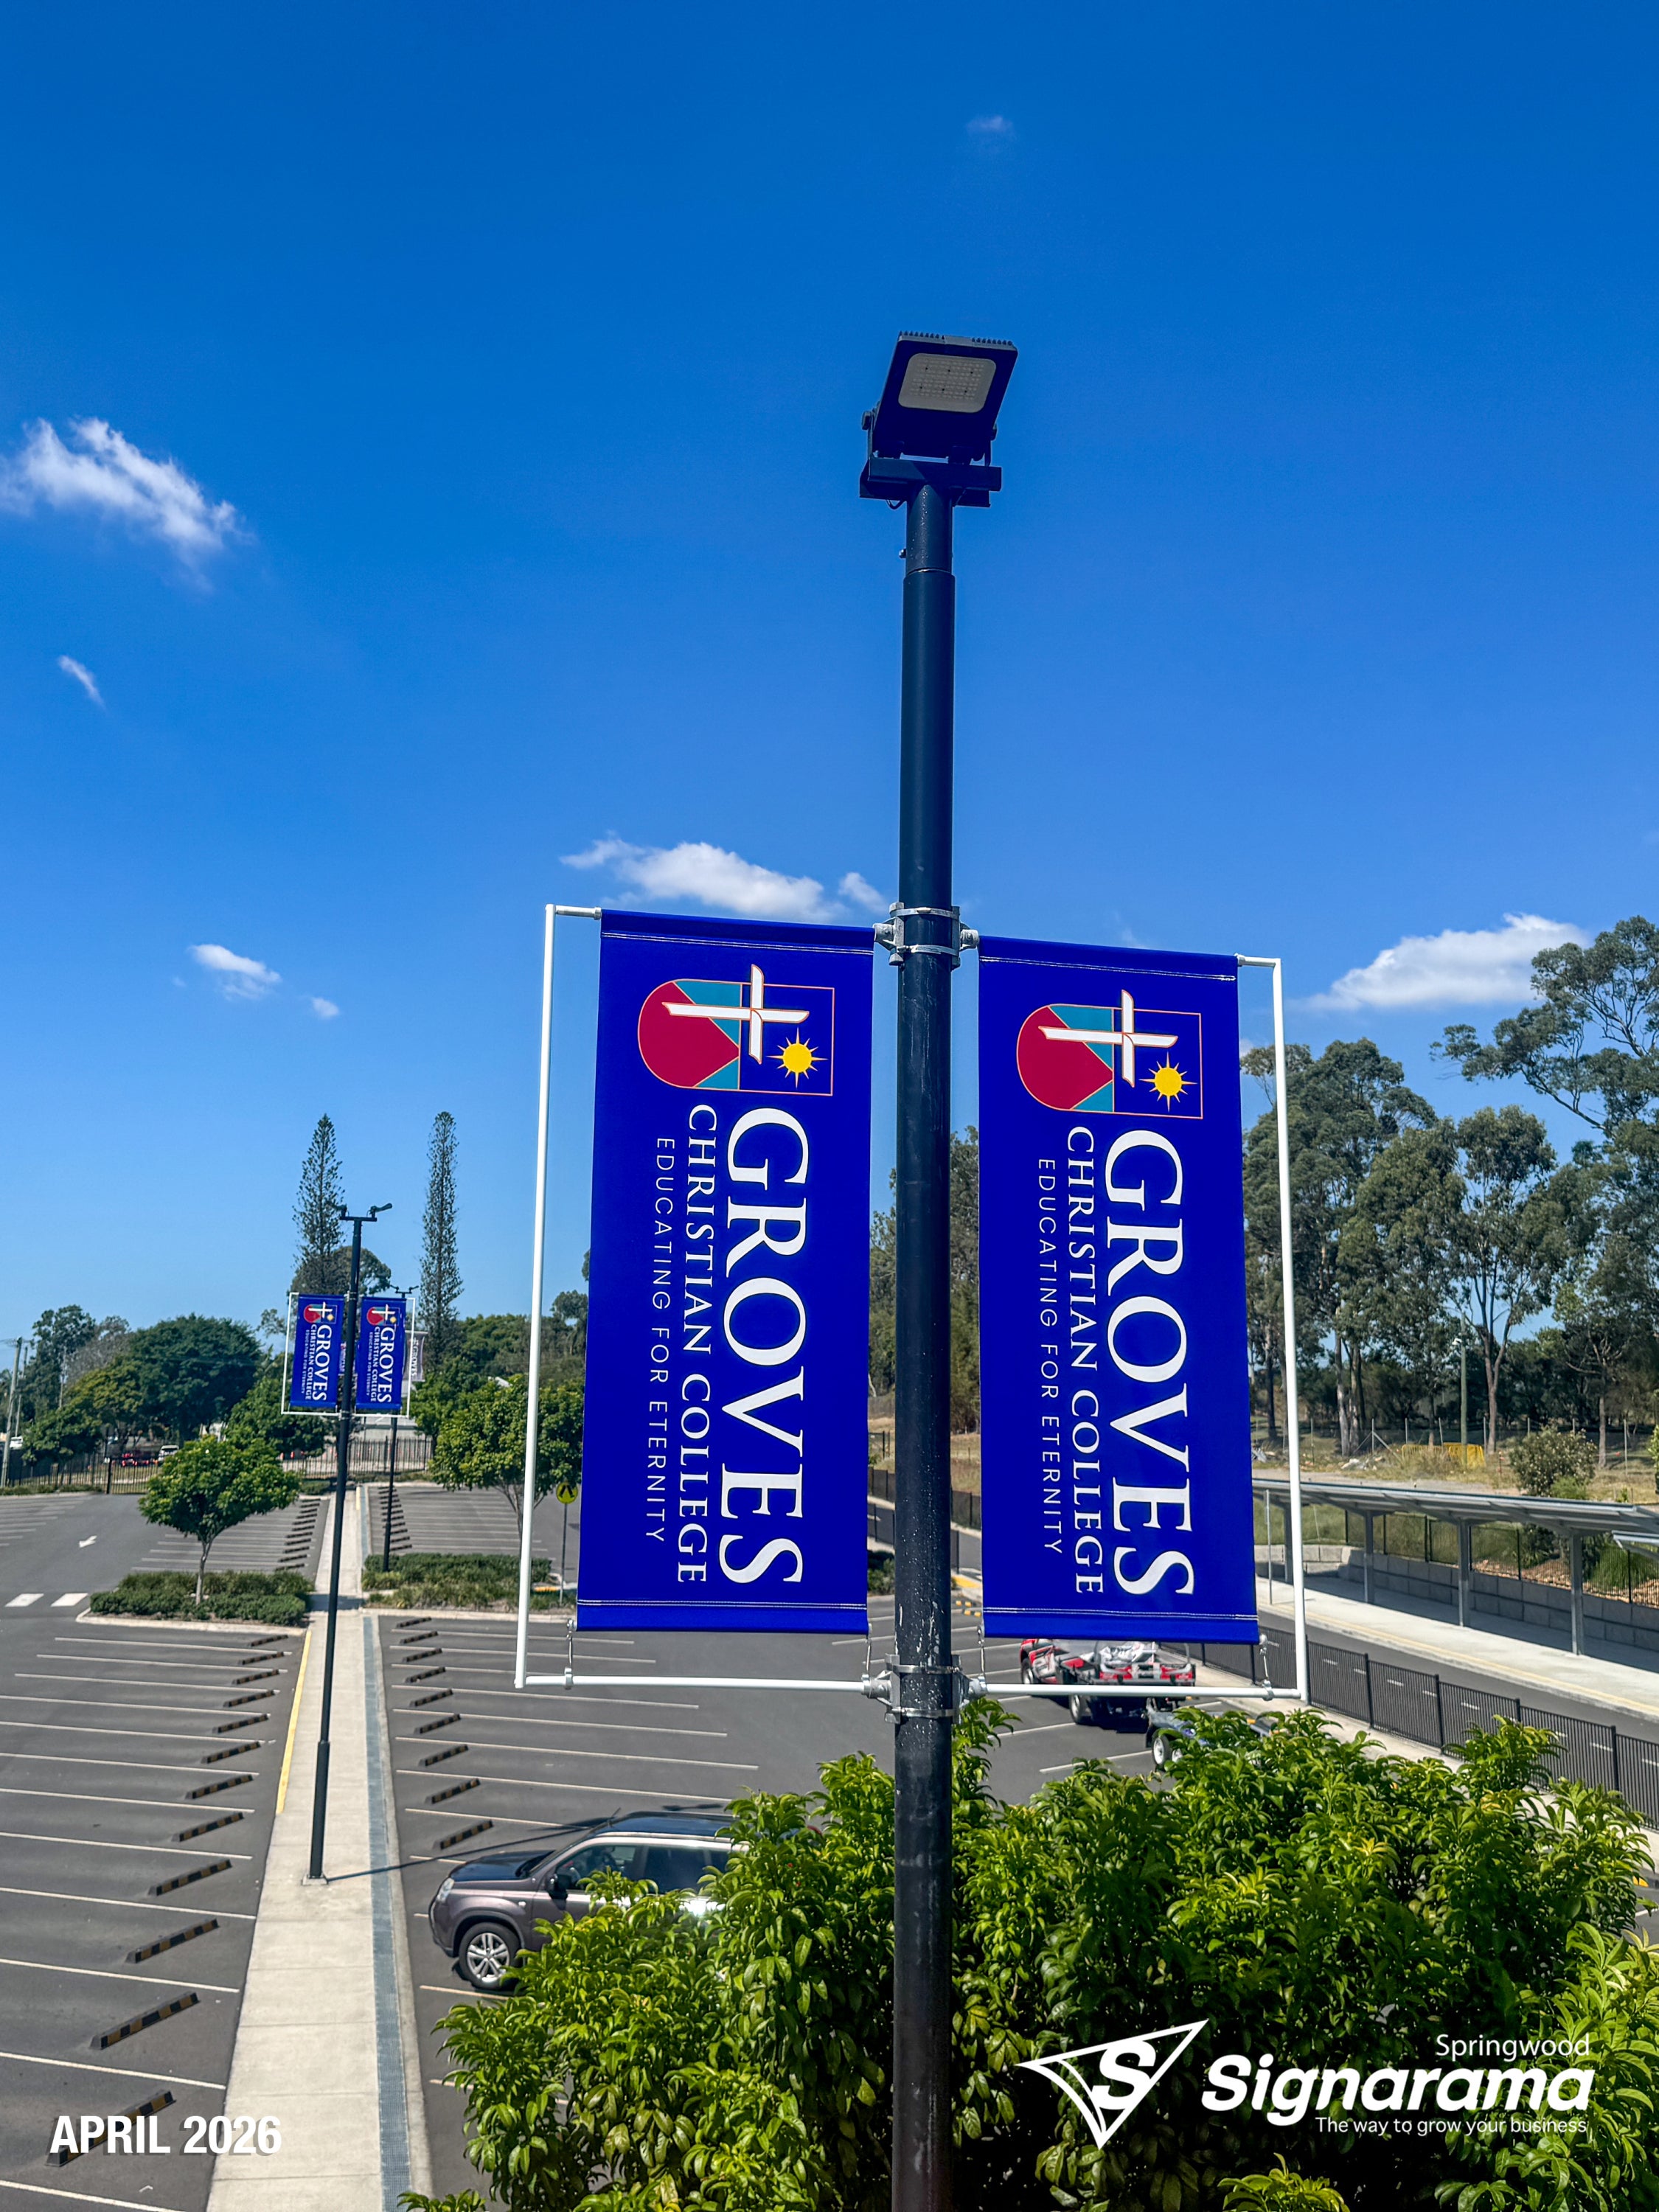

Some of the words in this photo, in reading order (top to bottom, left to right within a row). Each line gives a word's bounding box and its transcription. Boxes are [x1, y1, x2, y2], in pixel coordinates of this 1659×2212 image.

[651, 1138, 675, 1310] EDUCATING
[683, 1104, 717, 1354] CHRISTIAN
[1038, 1159, 1059, 1326] EDUCATING
[1067, 1126, 1098, 1371] CHRISTIAN
[305, 1367, 313, 1399] COLLEGE
[309, 1324, 317, 1365] CHRISTIAN
[313, 1324, 332, 1400] GROVES
[372, 1326, 380, 1368] CHRISTIAN
[378, 1326, 395, 1402] GROVES
[649, 1327, 669, 1382] FOR
[720, 1107, 809, 1584] GROVES
[1040, 1344, 1059, 1398] FOR
[1105, 1130, 1194, 1595] GROVES
[645, 1401, 667, 1542] ETERNITY
[678, 1374, 711, 1583] COLLEGE
[1042, 1416, 1062, 1554] ETERNITY
[1071, 1389, 1104, 1594] COLLEGE
